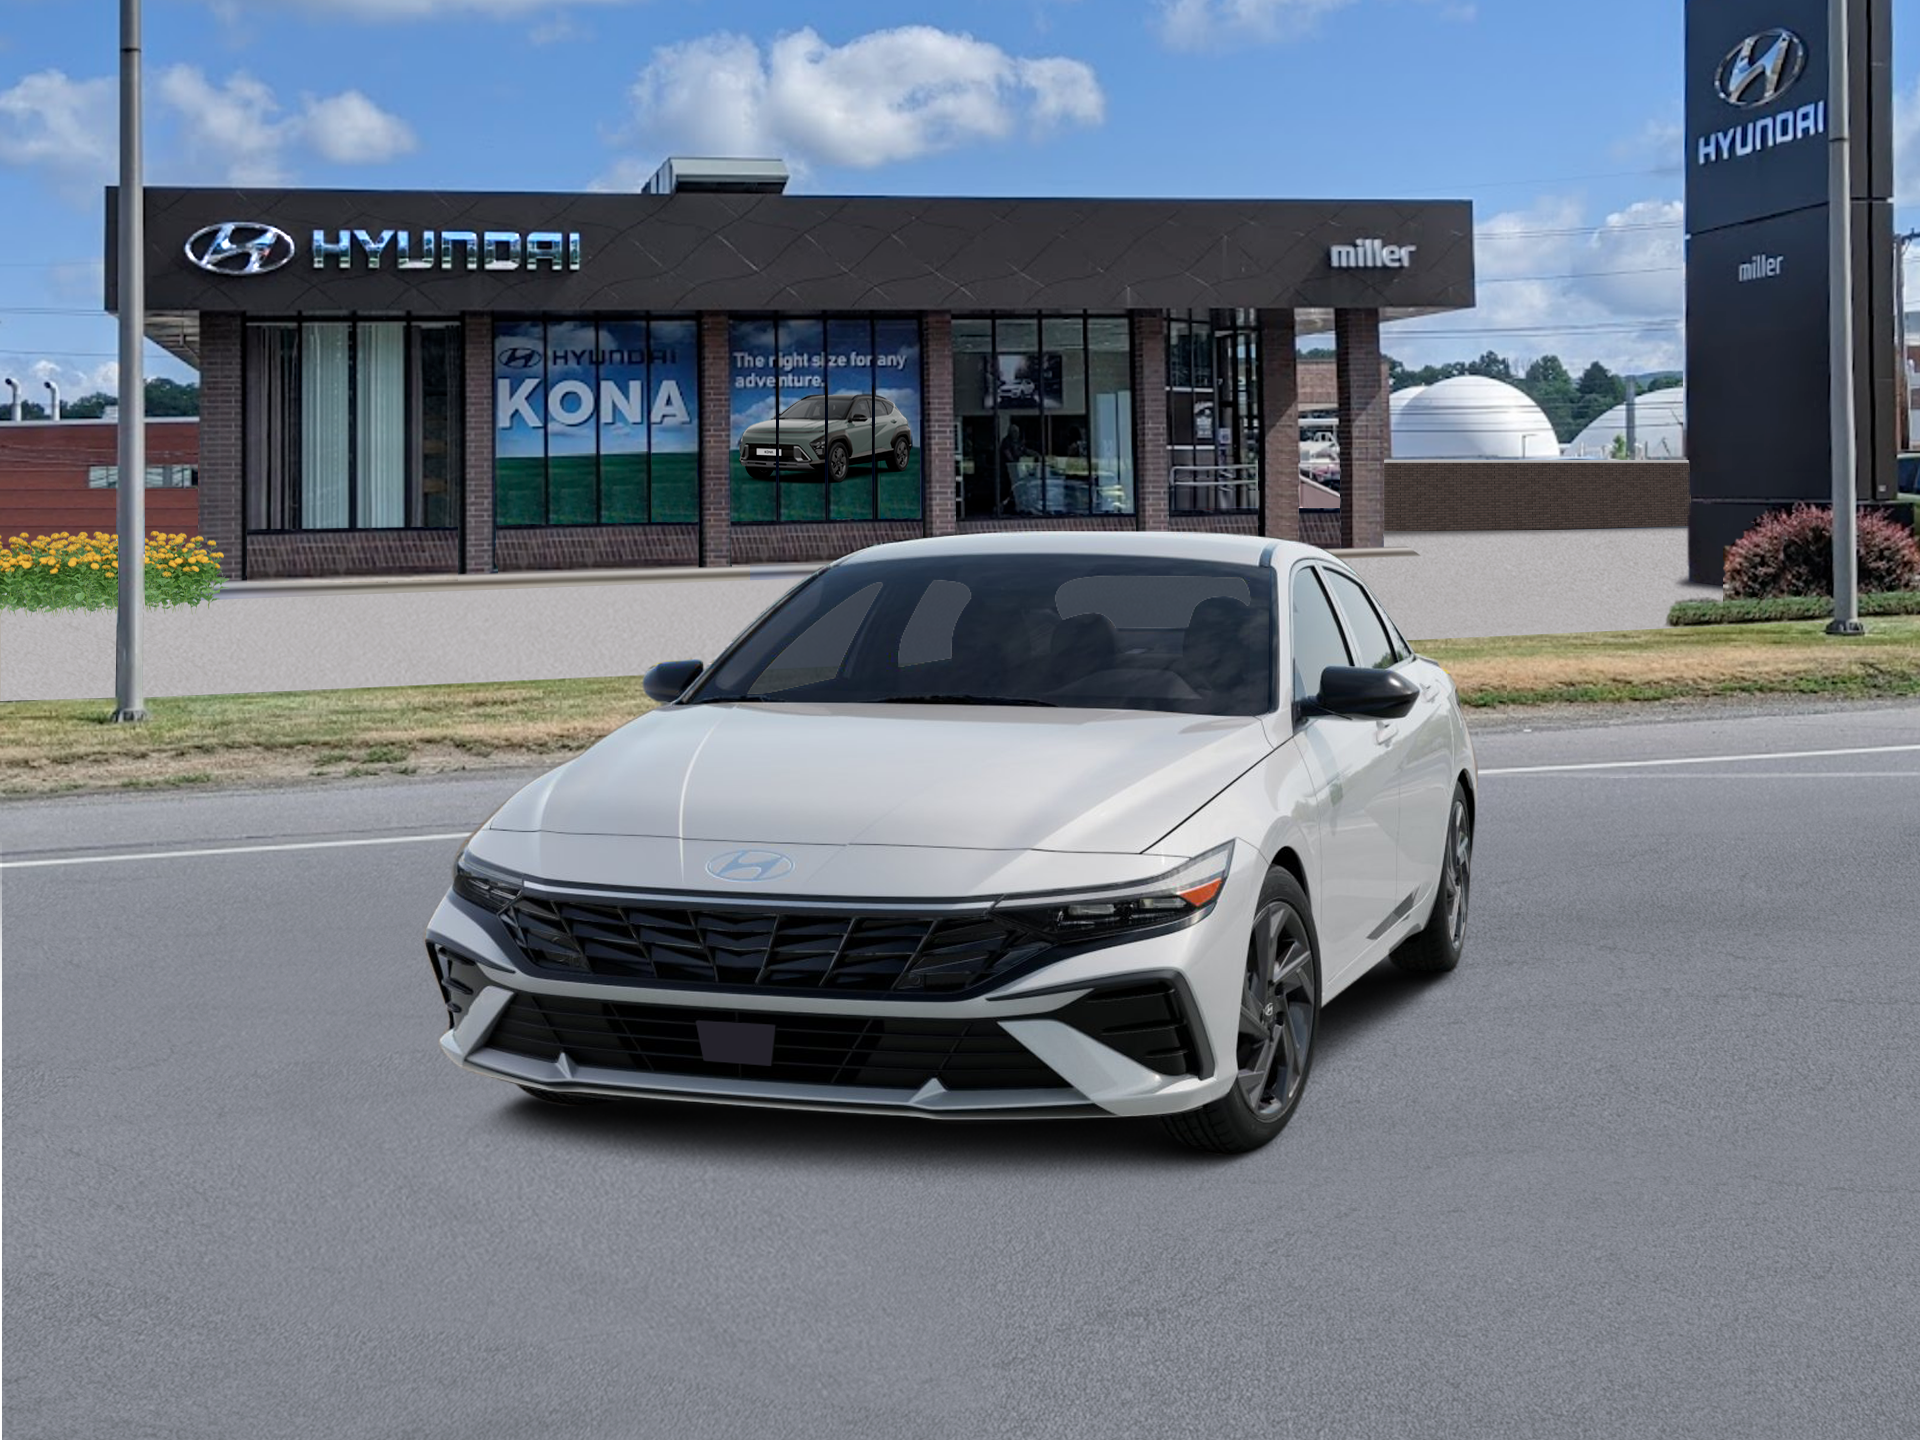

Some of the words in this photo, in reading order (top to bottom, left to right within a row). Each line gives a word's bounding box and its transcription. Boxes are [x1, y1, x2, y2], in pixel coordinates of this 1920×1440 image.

[1698, 100, 1824, 165] HYUNDAI
[312, 229, 580, 271] HYUNDAI
[1330, 238, 1417, 268] miller
[1738, 254, 1784, 282] miller
[553, 349, 677, 365] HYUNDAI
[733, 351, 765, 368] The
[768, 351, 808, 371] right
[811, 351, 847, 368] size
[849, 351, 873, 367] for
[877, 354, 907, 371] any
[735, 373, 825, 388] adventure.
[497, 378, 690, 428] KONA
